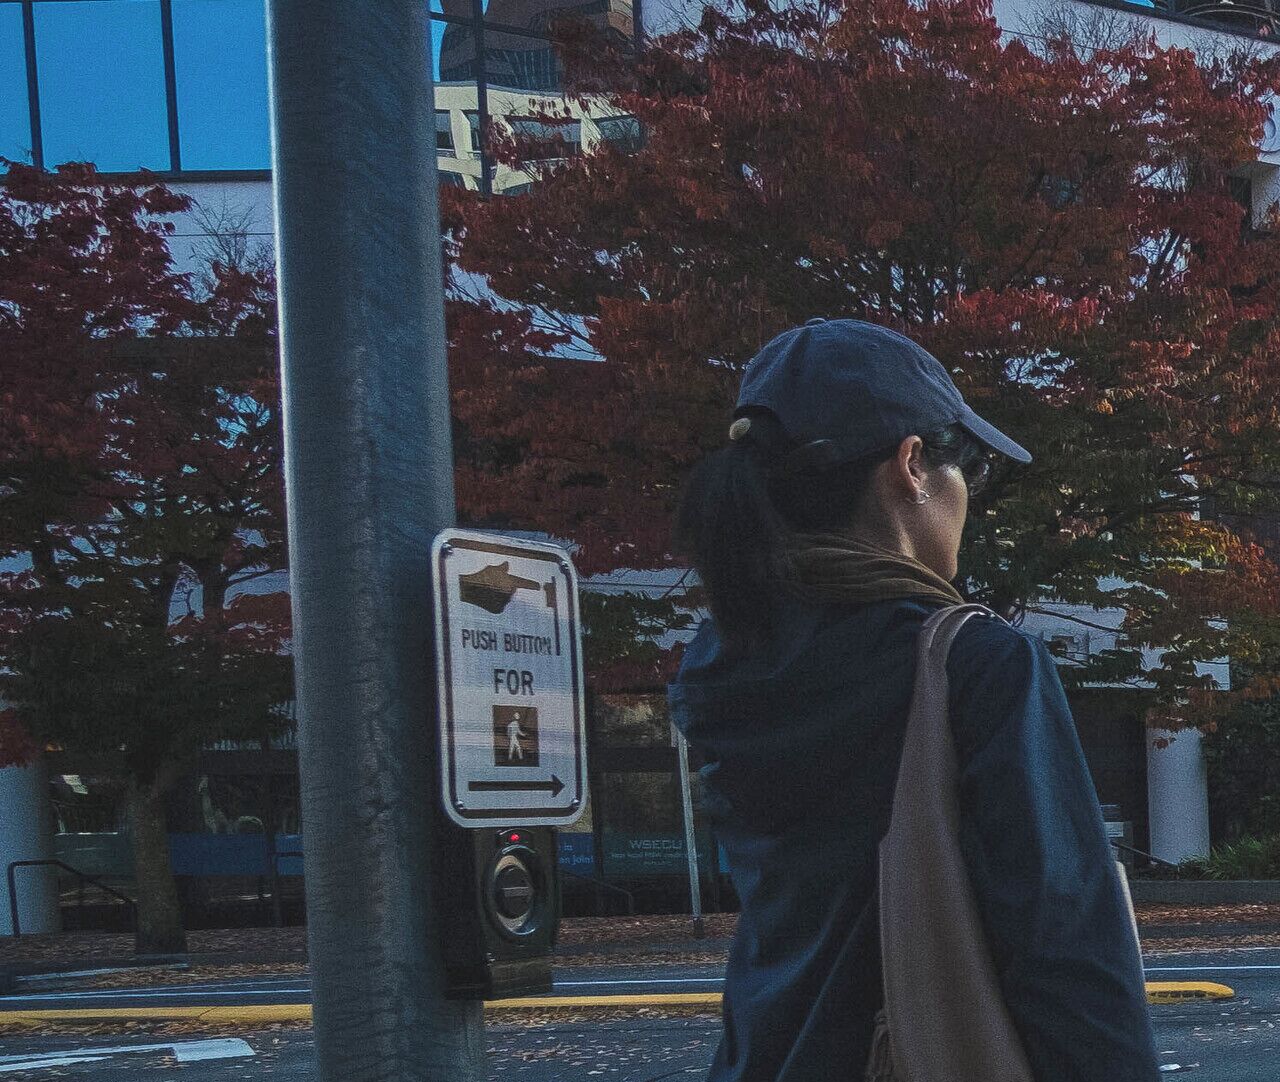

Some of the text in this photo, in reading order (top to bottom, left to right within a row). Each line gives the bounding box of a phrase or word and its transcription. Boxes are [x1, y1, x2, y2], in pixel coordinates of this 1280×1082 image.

[461, 628, 552, 656] PUSH BUTTON
[494, 668, 535, 696] FOR
